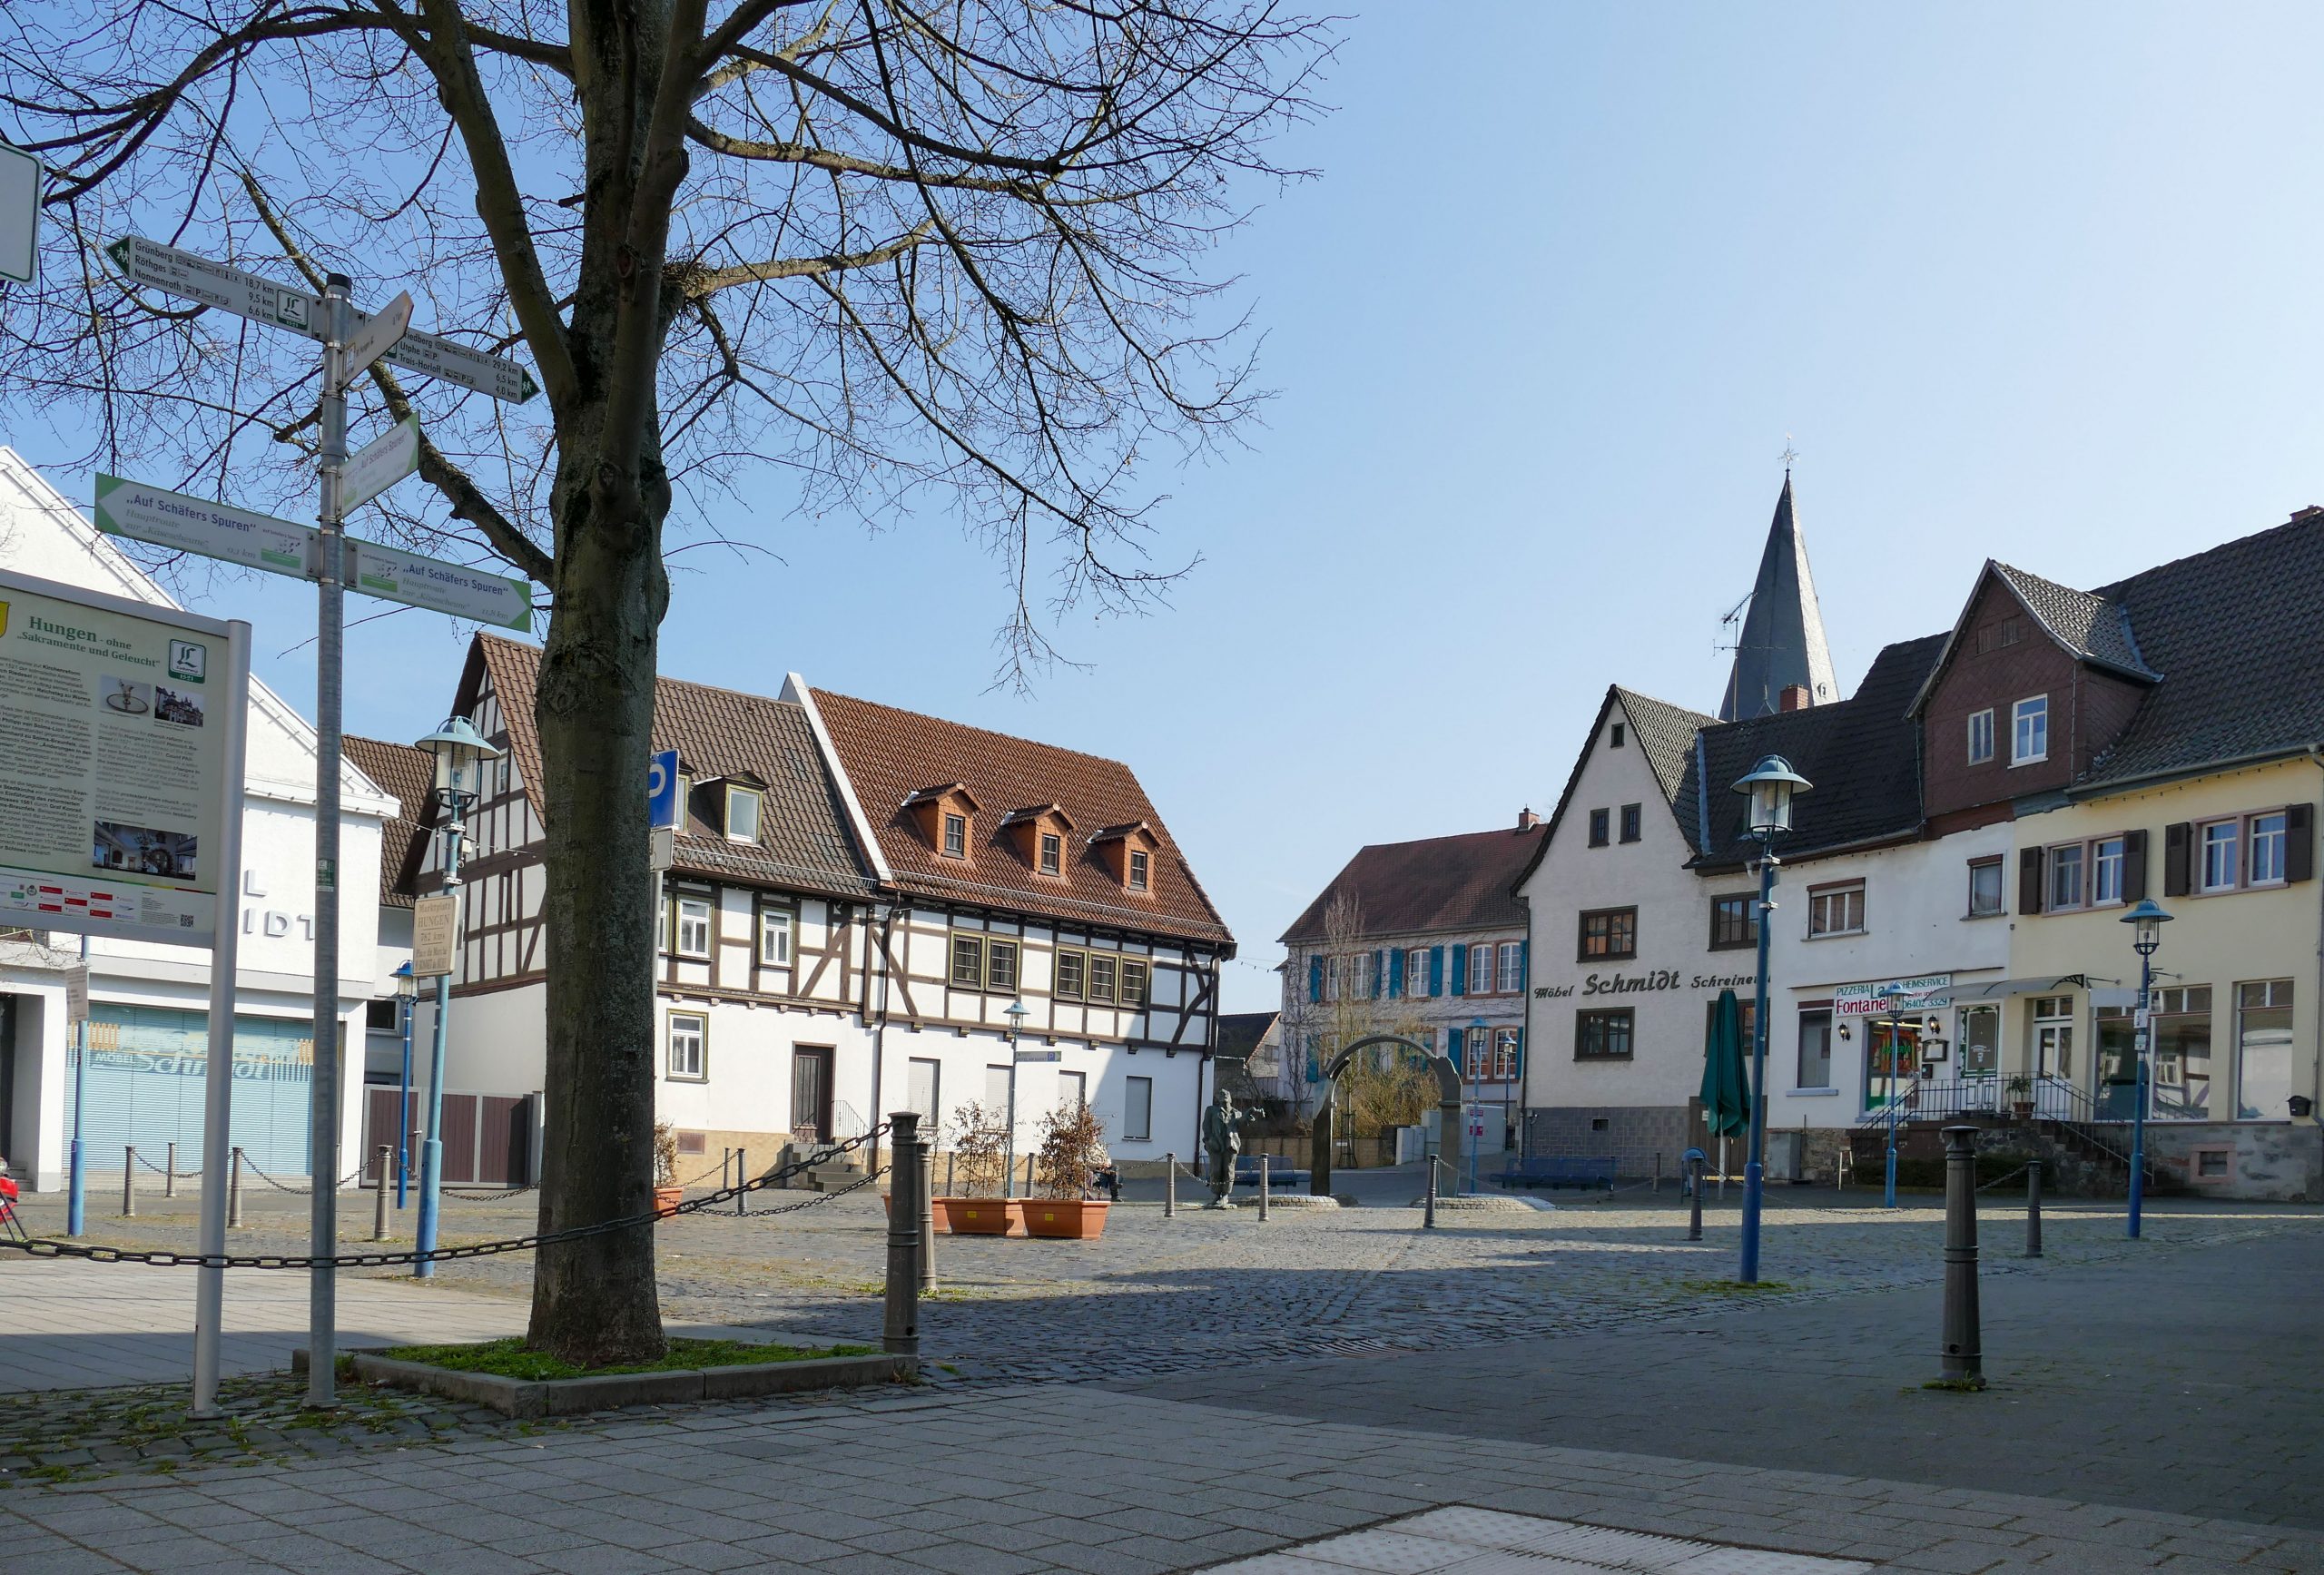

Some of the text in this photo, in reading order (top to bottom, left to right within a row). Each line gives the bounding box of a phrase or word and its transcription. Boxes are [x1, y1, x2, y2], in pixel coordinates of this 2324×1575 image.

[135, 241, 173, 263] Grünberg
[135, 255, 167, 273] Röthges
[135, 268, 181, 291] Nonnenroth
[245, 277, 274, 295] 18,7 km
[248, 292, 274, 308] 9,5 km
[248, 305, 274, 321] 6,6 km
[400, 341, 420, 354] Utphe
[399, 354, 441, 373] Trais-Horloff
[492, 360, 518, 376] 29,2 km
[496, 374, 517, 387] 6,5 km
[496, 385, 517, 399] 4,0 km
[126, 509, 180, 529] Hauptroute
[127, 494, 256, 532] „Auf Schäfers Spuren“
[125, 522, 140, 531] zur
[241, 548, 255, 559] km
[403, 564, 509, 596] „Auf Schäfers Spuren“
[402, 577, 446, 594] Hauptroute
[497, 609, 508, 620] km
[29, 616, 97, 642] Hungen
[106, 635, 132, 650] ohne
[17, 631, 160, 667] „Sakramente und Geleucht“
[418, 914, 450, 928] HUNGEN
[1534, 985, 1575, 999] Möbel
[1582, 970, 1680, 995] Schmidt
[1837, 977, 1947, 999] PIZZERIA La HEIMSERVICE
[1903, 999, 1925, 1009] 06402
